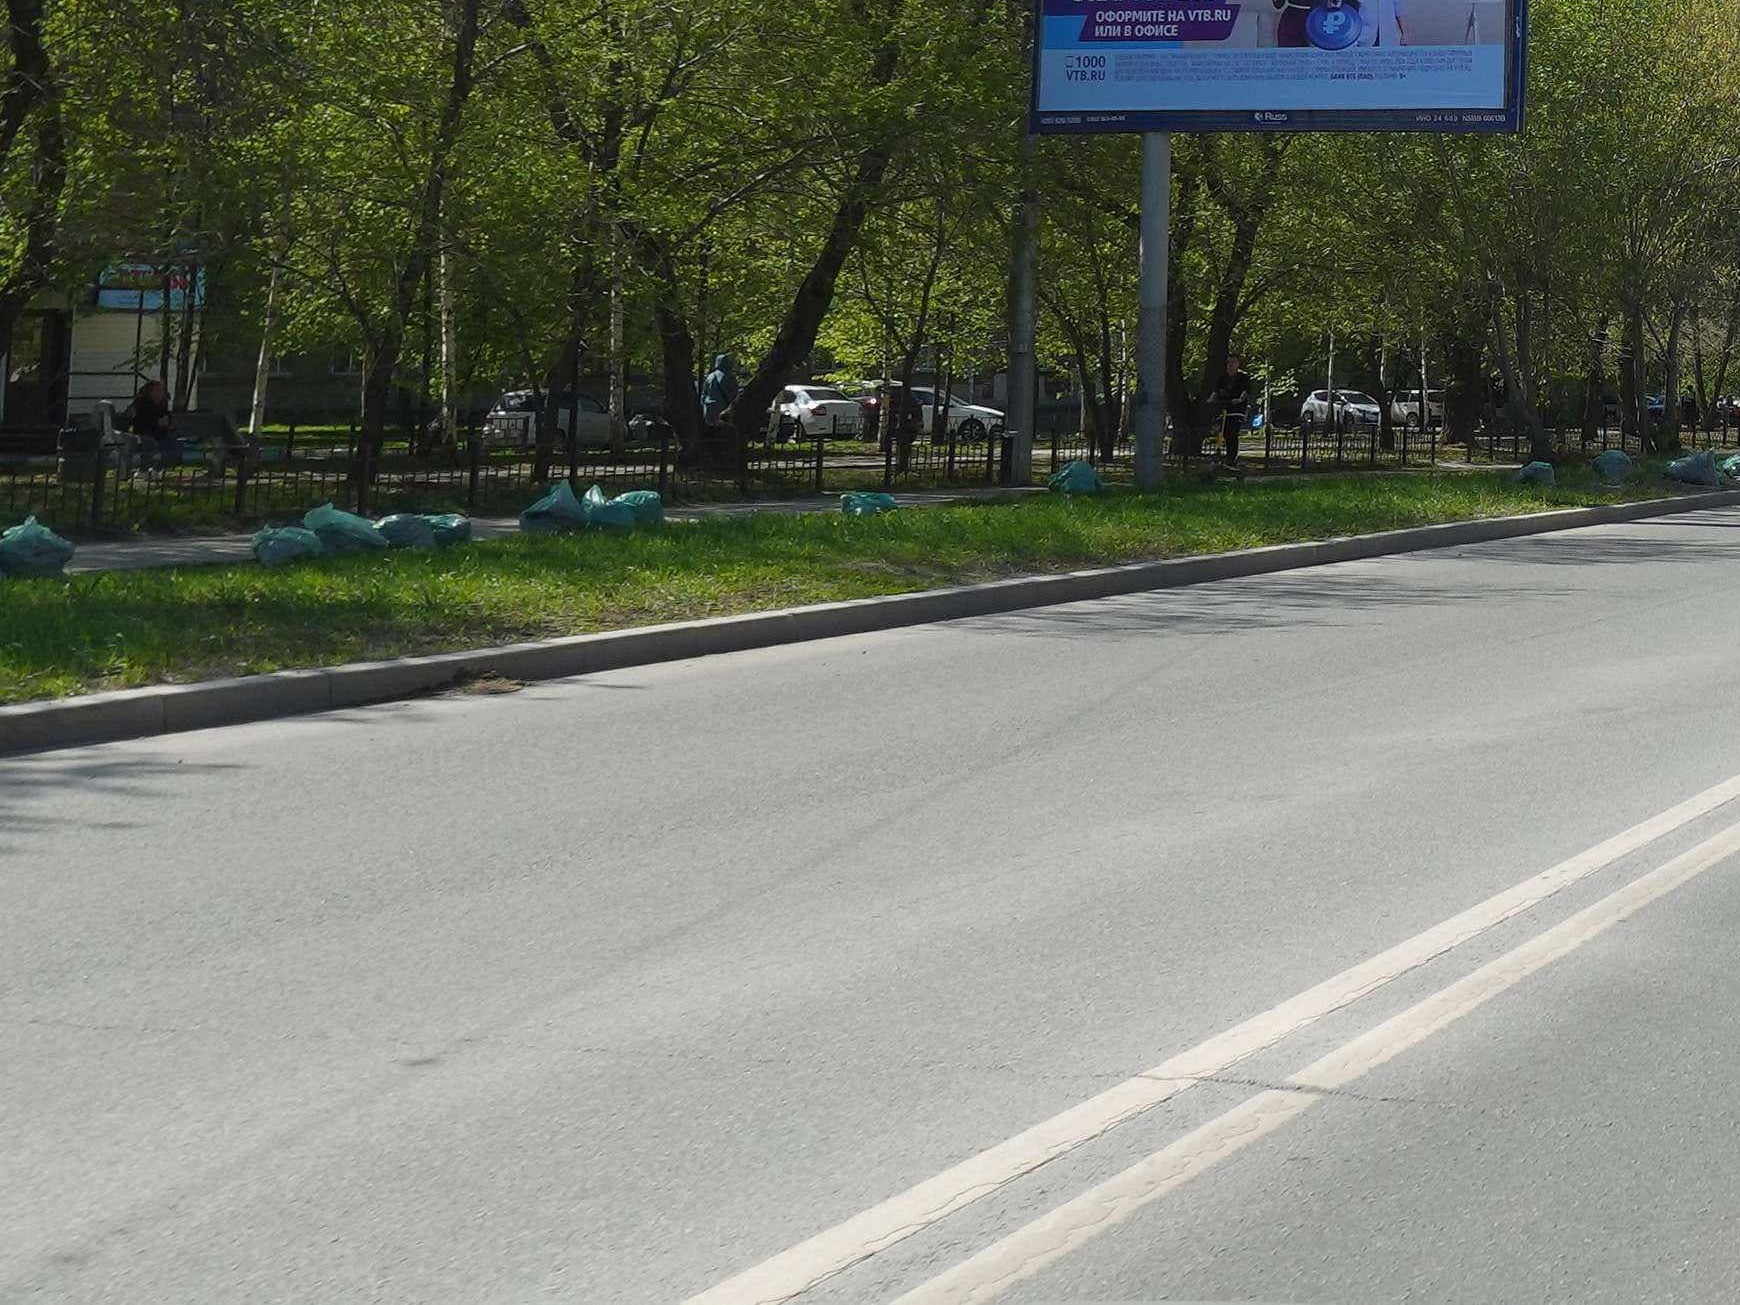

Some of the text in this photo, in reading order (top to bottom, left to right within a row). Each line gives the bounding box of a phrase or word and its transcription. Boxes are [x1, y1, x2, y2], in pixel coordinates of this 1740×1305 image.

[1095, 9, 1231, 23] ОФОРМИТЕ НА VTB.RU
[1095, 25, 1179, 37] ИЛИ В ОФИСЕ
[1076, 56, 1106, 68] 1000
[1066, 69, 1106, 81] VTB.RU
